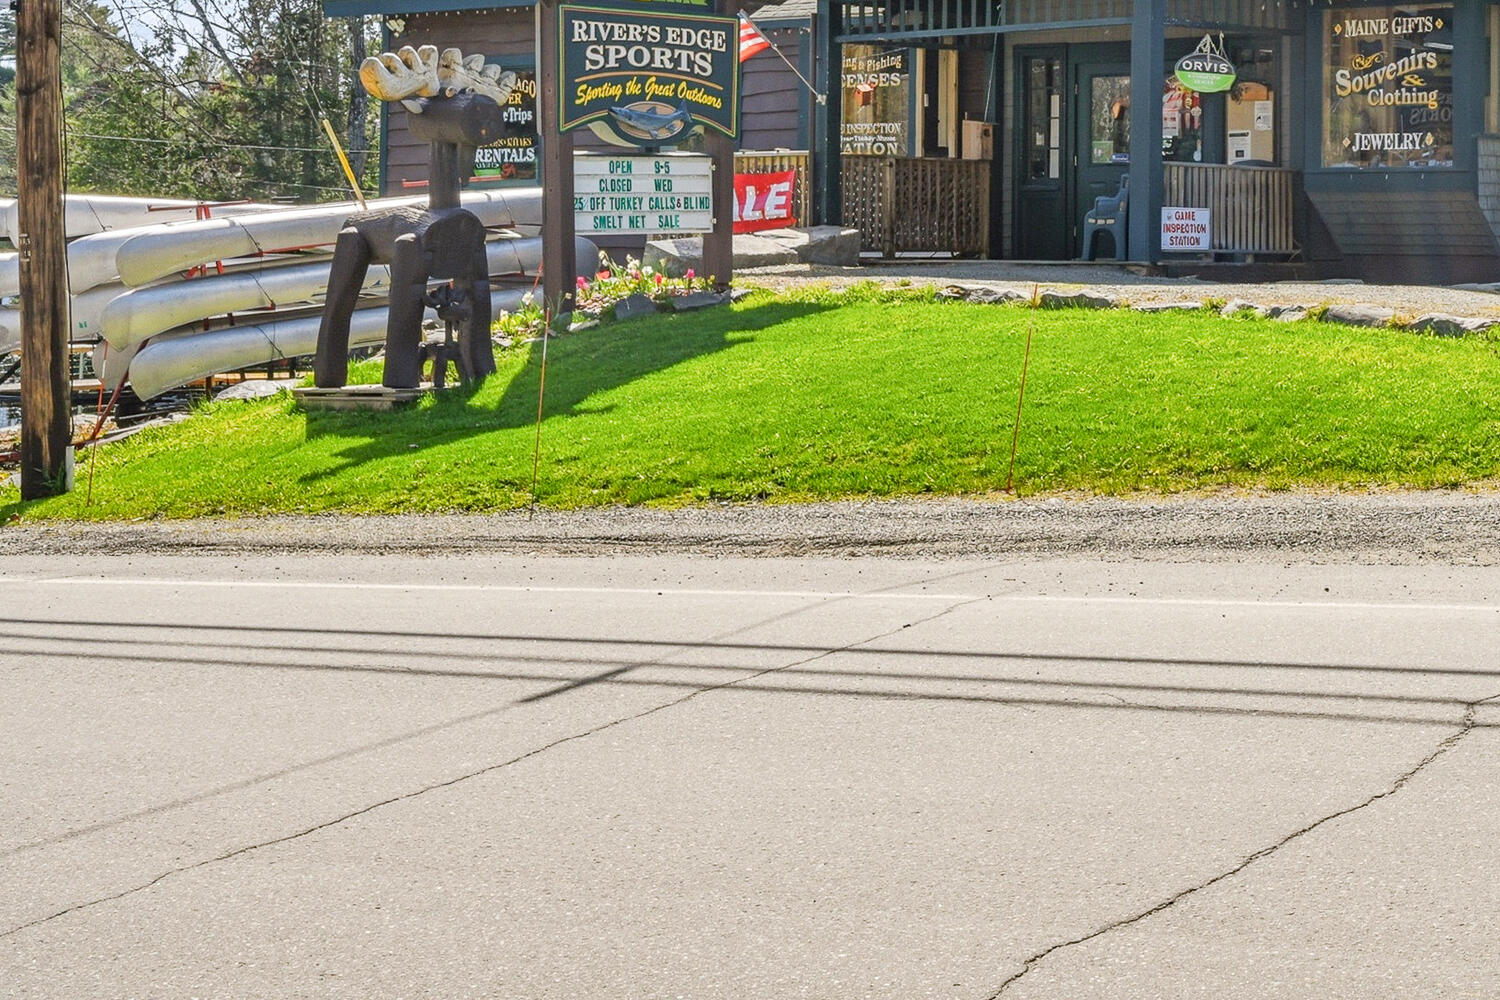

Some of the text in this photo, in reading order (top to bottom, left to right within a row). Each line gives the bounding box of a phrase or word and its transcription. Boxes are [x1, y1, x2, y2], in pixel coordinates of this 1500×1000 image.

[1344, 15, 1434, 38] MAINE GIFTS
[571, 19, 727, 52] RIVER'S EDGE
[585, 44, 713, 77] SPORTS
[1182, 59, 1229, 74] ORVIS
[1335, 48, 1438, 97] Souvenirs
[1401, 74, 1427, 88] &
[574, 76, 723, 110] Sporting the Great Outdoors
[1367, 87, 1439, 110] Clothing
[840, 142, 900, 155] ATION
[1351, 131, 1424, 153] JEWELRY
[475, 147, 536, 163] RENTALS
[609, 160, 671, 174] OPEN 9-5
[599, 178, 673, 193] CLOSED WED
[590, 196, 607, 211] OFF
[609, 196, 644, 211] TURKEY
[648, 196, 676, 211] CALLS
[683, 196, 710, 210] BLIND
[733, 181, 791, 222] LE
[593, 214, 681, 229] SMELT NET SALE
[1174, 210, 1196, 221] GAME
[1163, 223, 1207, 234] INSPECTION
[1169, 235, 1201, 246] STATION
